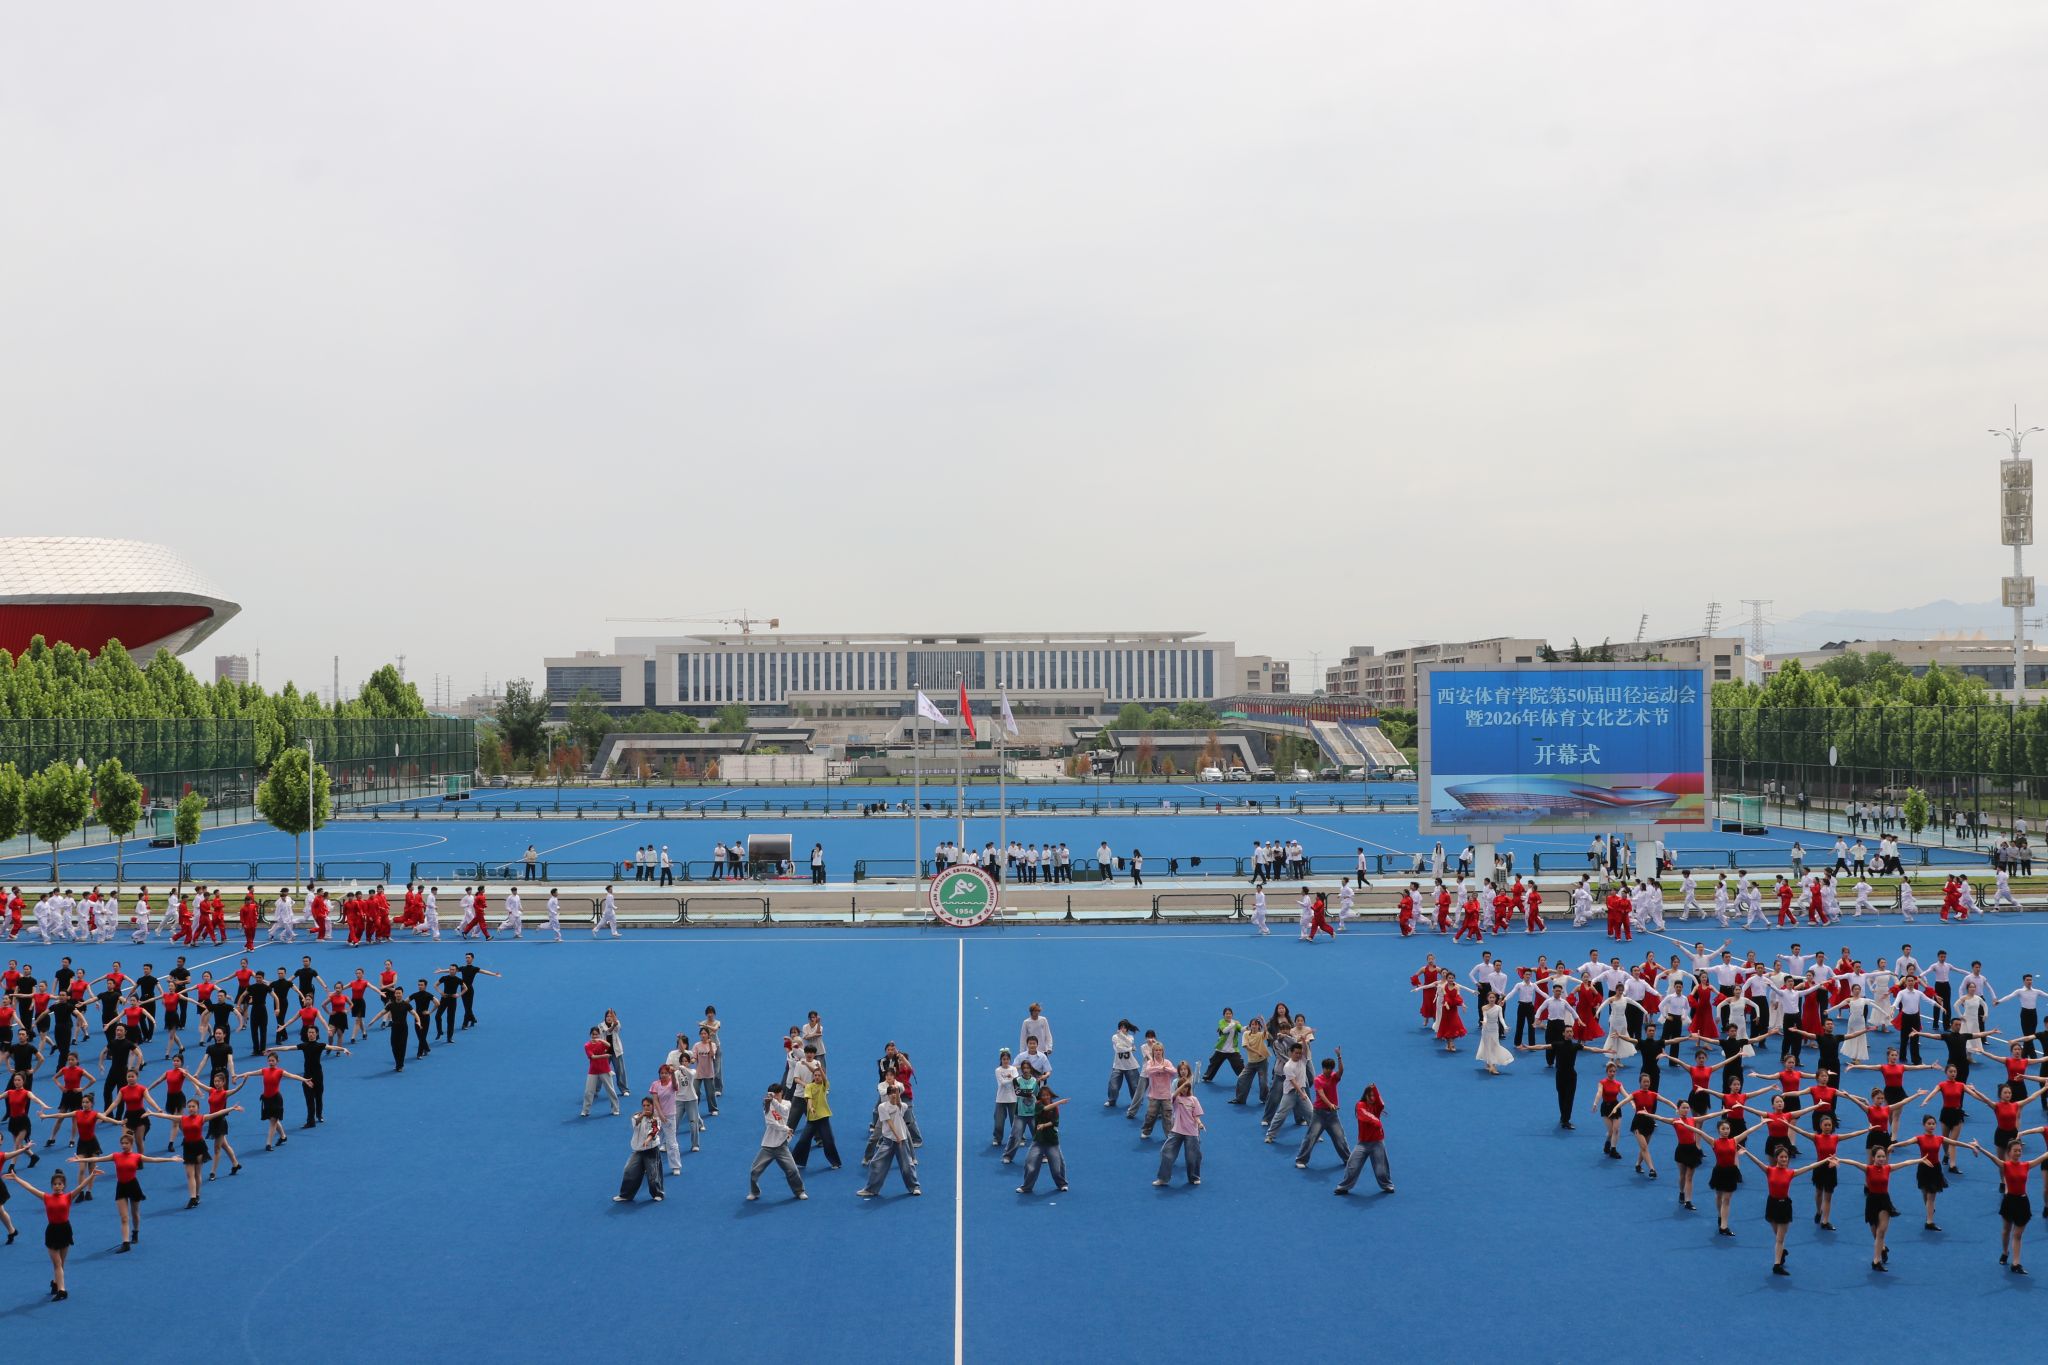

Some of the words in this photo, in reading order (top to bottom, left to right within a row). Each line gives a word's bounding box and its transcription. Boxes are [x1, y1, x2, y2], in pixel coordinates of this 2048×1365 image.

[1438, 685, 1696, 704] 西安体育学院第50届田径运动会
[1465, 708, 1669, 727] 暨2026年体育文化艺术节
[1534, 744, 1600, 765] 开幕式
[953, 867, 984, 878] EDUCATION
